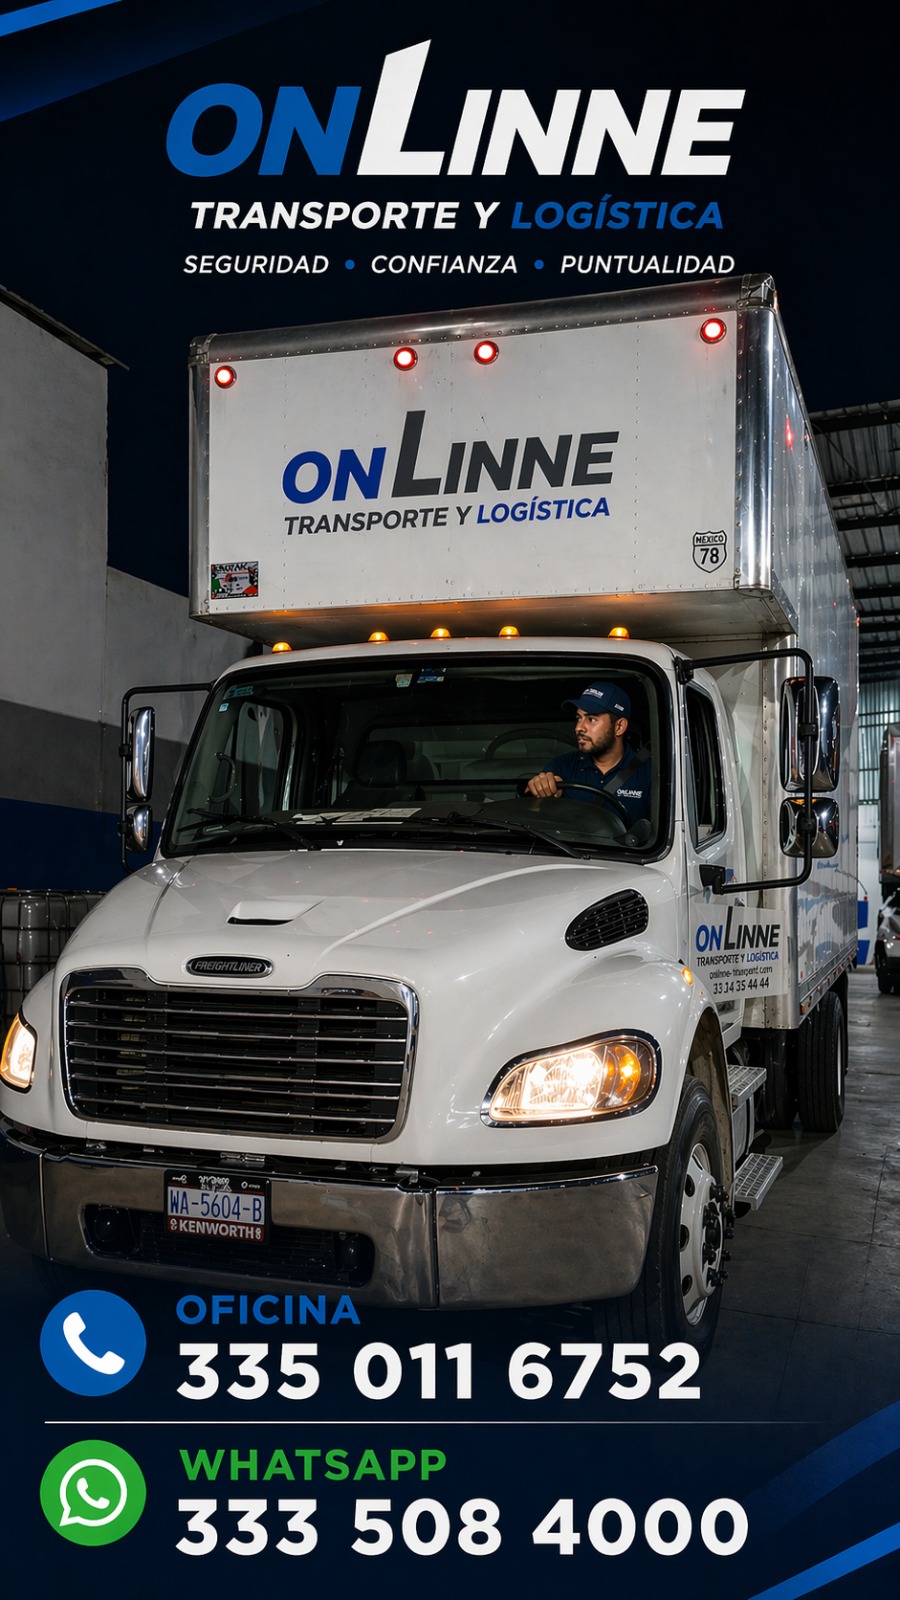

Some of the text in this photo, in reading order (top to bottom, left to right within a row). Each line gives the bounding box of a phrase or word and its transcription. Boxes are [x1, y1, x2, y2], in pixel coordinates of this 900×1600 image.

[281, 410, 620, 504] ONLINNE
[284, 496, 611, 536] TRANSPORTE Y LOGÍSTICA
[700, 547, 719, 565] 78
[695, 906, 780, 952] ONLINNE
[194, 960, 262, 972] FREIGHTLINER
[696, 951, 779, 967] TRANSPORTE Y LOGÍSTICA
[736, 979, 747, 992] 35
[748, 978, 758, 990] 44
[760, 977, 770, 989] 44
[170, 1190, 262, 1222] WA-5604-B
[179, 1219, 254, 1239] KENWORTH
